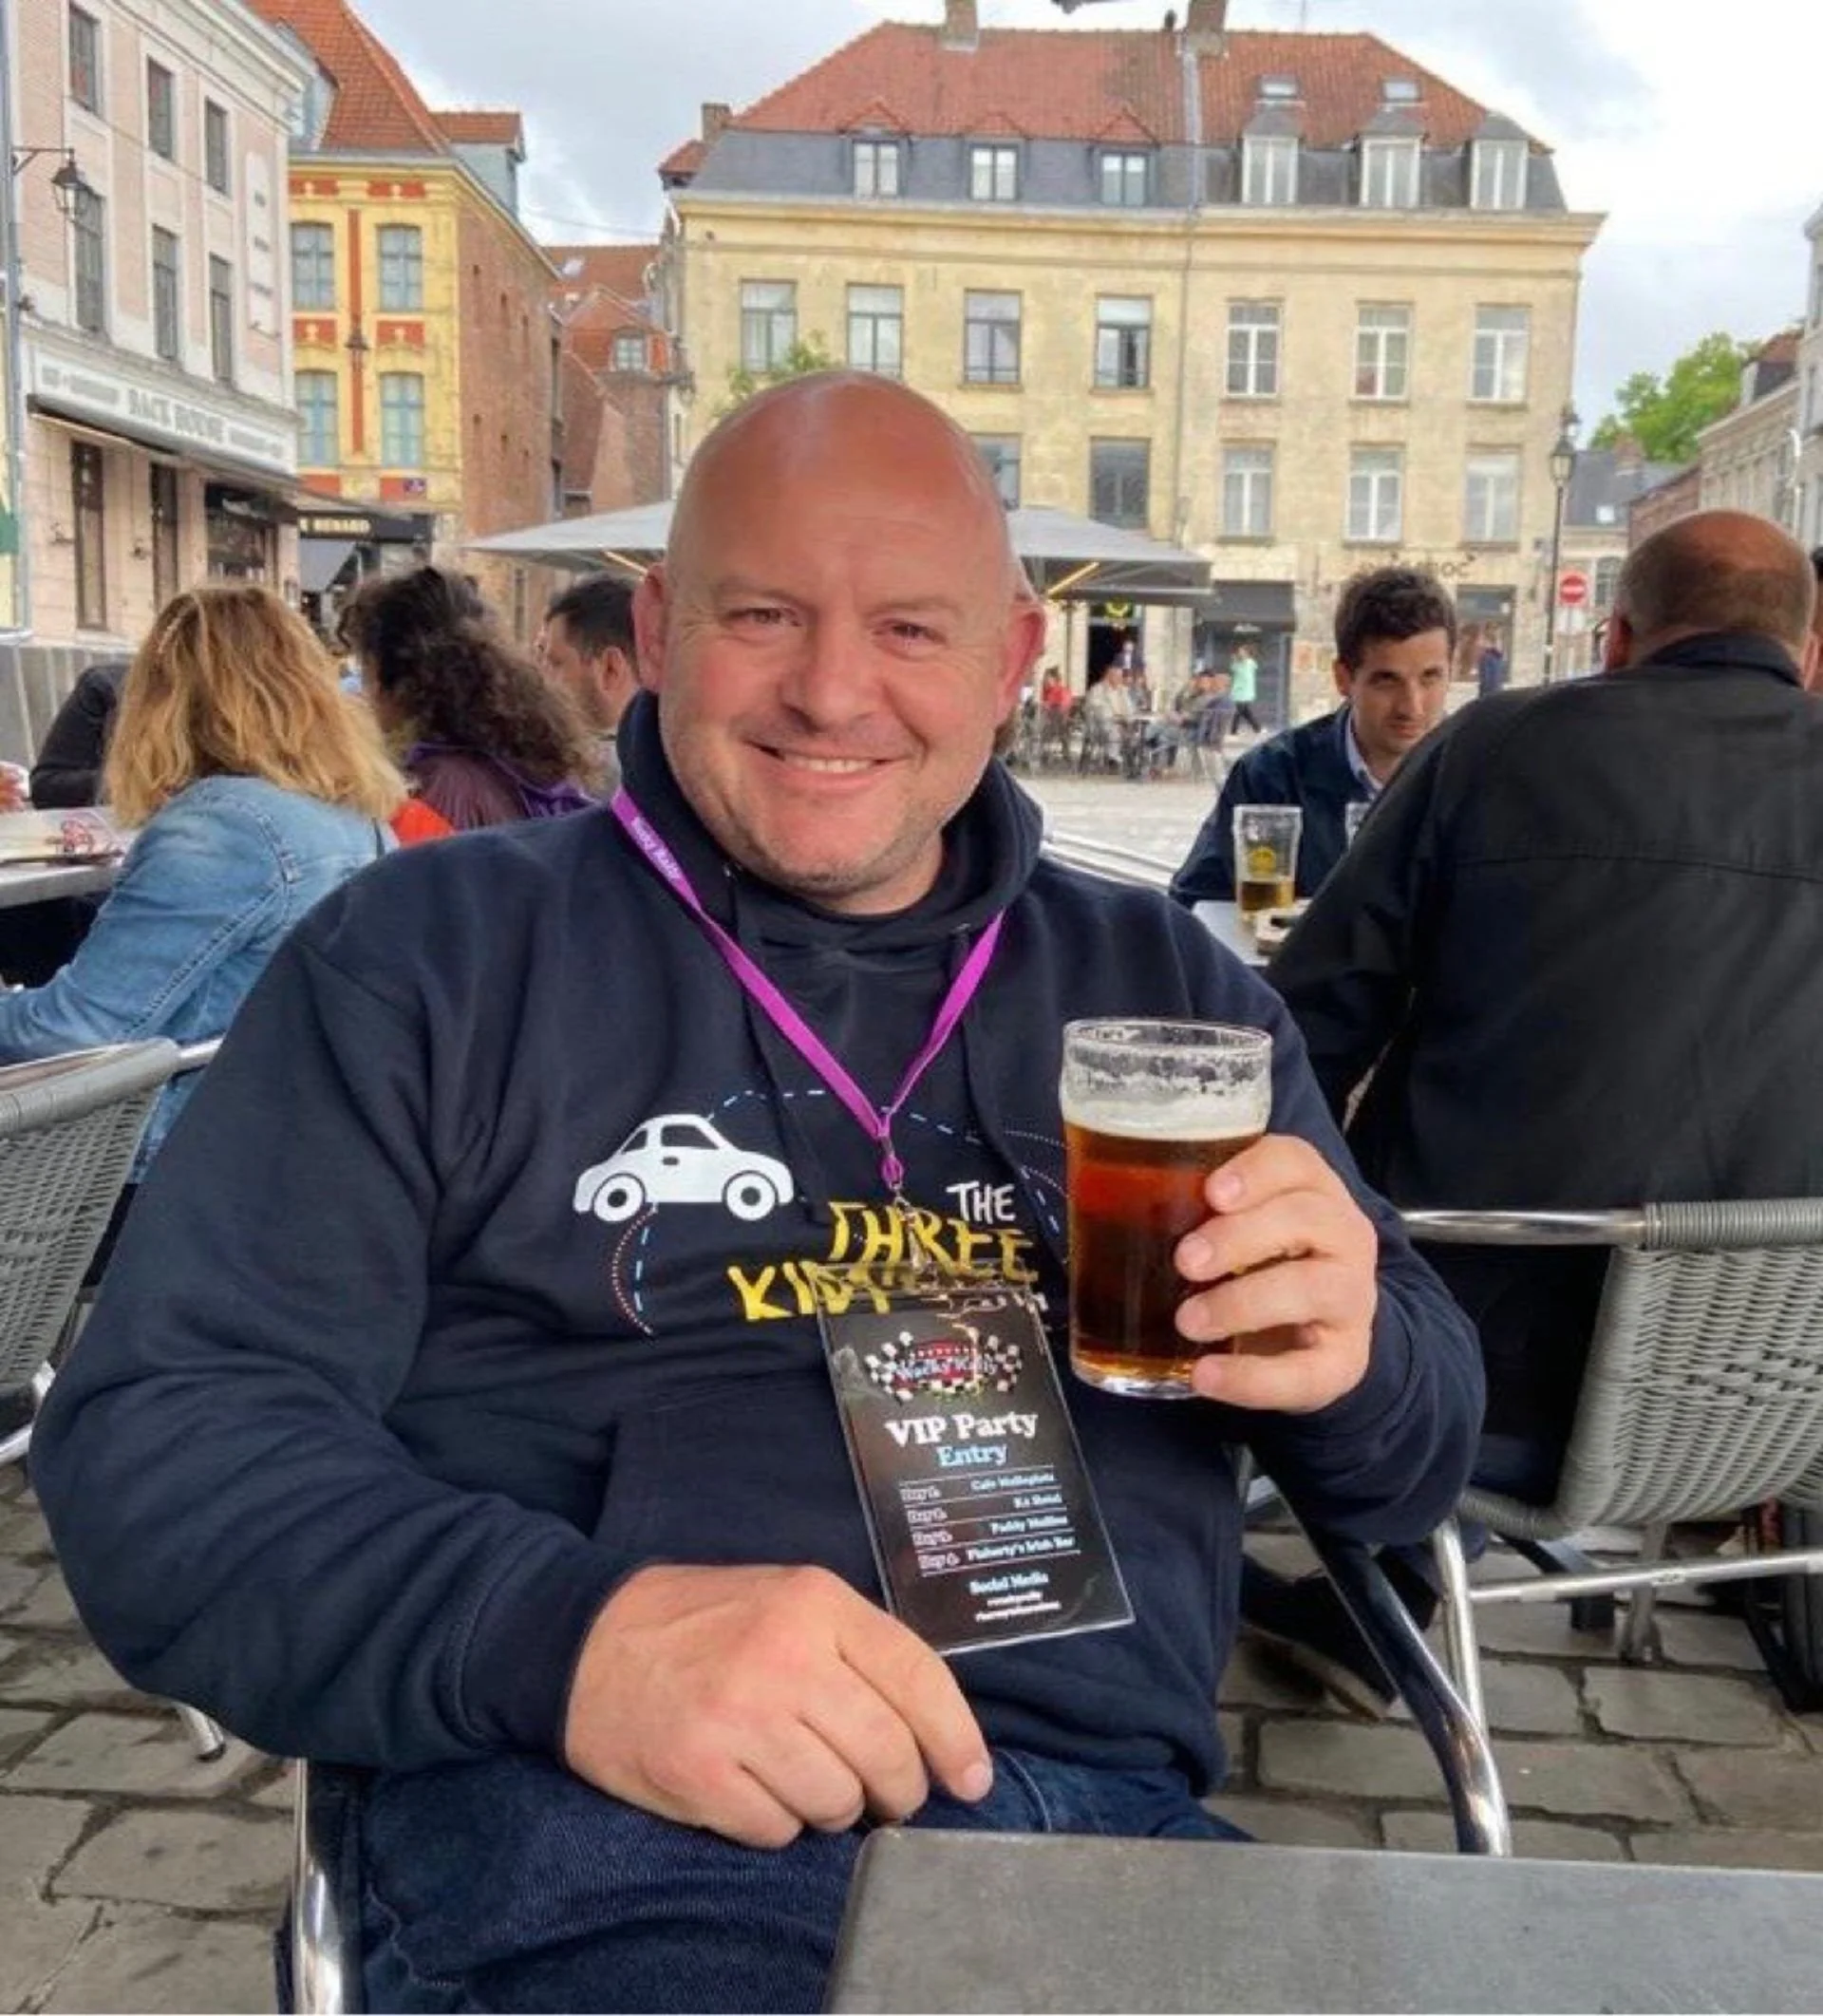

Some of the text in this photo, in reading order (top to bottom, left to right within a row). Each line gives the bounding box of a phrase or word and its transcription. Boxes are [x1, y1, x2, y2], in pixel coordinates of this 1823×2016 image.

[946, 1180, 1017, 1224] THE
[828, 1201, 1039, 1282] THREE
[884, 1411, 1039, 1447] VIP Party
[935, 1443, 1007, 1467] Entry
